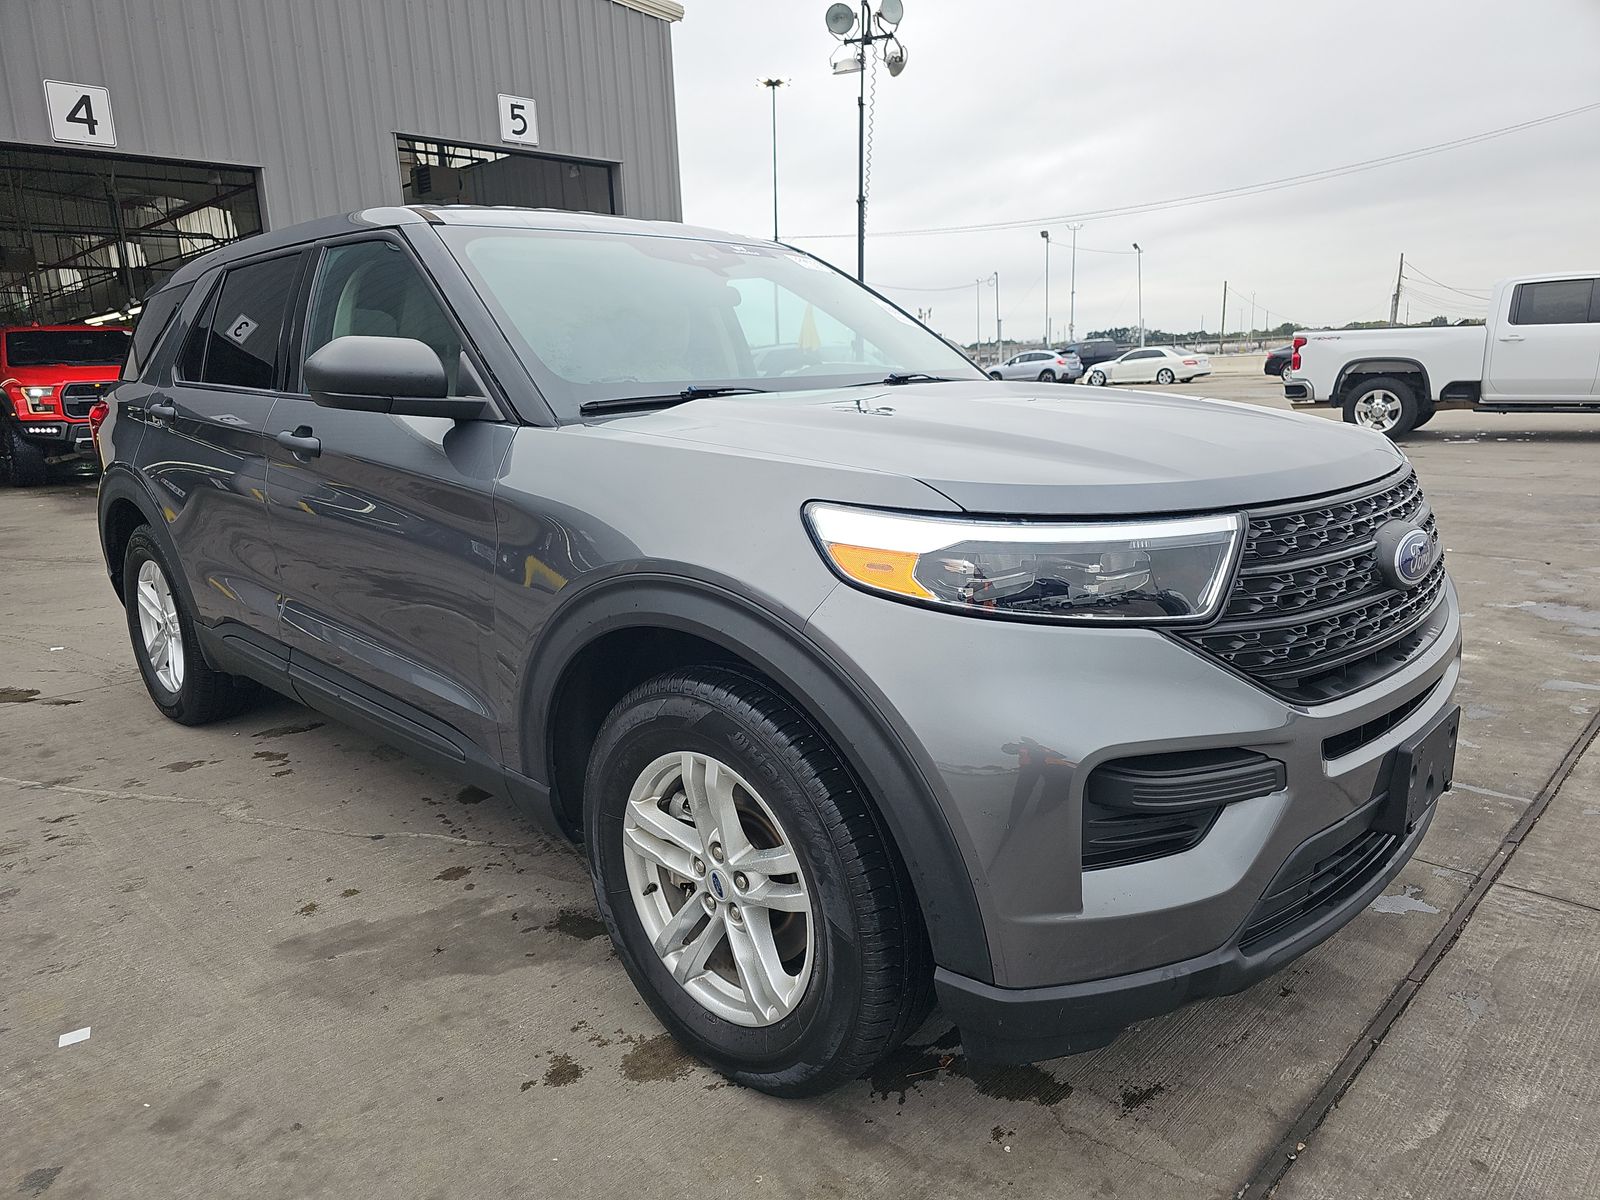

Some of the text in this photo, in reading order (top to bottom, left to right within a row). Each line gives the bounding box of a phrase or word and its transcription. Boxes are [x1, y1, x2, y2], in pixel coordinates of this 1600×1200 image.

[65, 94, 99, 136] 4
[510, 103, 528, 136] 5
[1409, 540, 1430, 574] Ford
